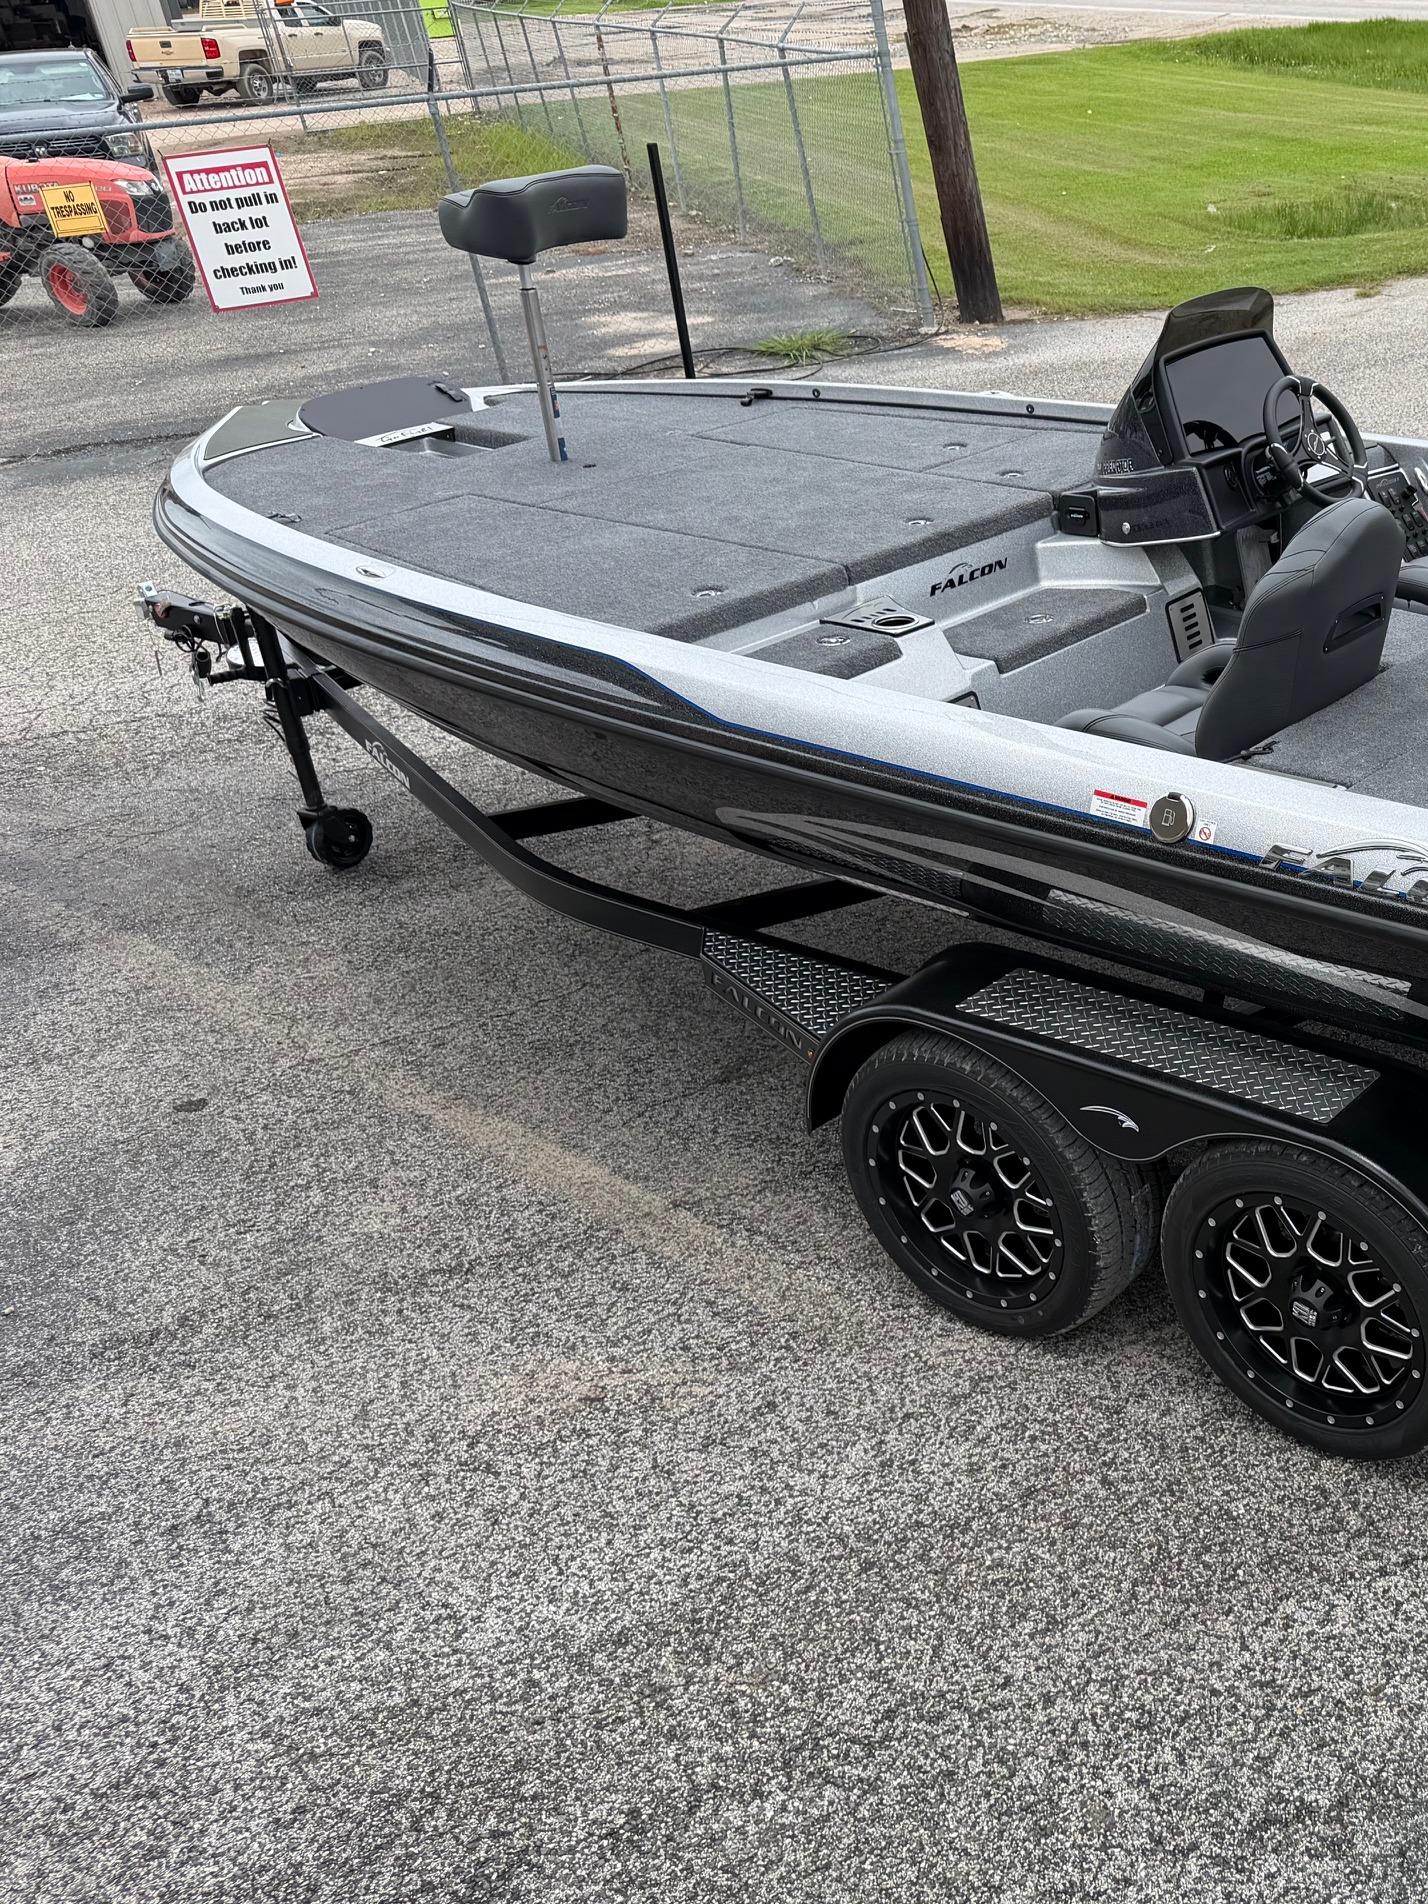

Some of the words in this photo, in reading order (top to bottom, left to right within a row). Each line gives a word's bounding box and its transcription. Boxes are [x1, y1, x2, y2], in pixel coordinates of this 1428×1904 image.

[183, 166, 269, 192] Attention
[63, 190, 75, 203] NO
[187, 201, 208, 214] Do
[210, 197, 234, 213] not
[235, 192, 263, 210] pull
[264, 191, 279, 205] in
[50, 202, 98, 219] TRESPASSING
[212, 217, 249, 234] back
[250, 215, 270, 230] lot
[225, 239, 272, 256] before
[213, 261, 278, 280] checking
[279, 256, 298, 271] in!
[240, 284, 268, 296] Thank
[268, 282, 285, 293] you
[930, 557, 1008, 597] FALCON
[364, 739, 411, 790] FALCON
